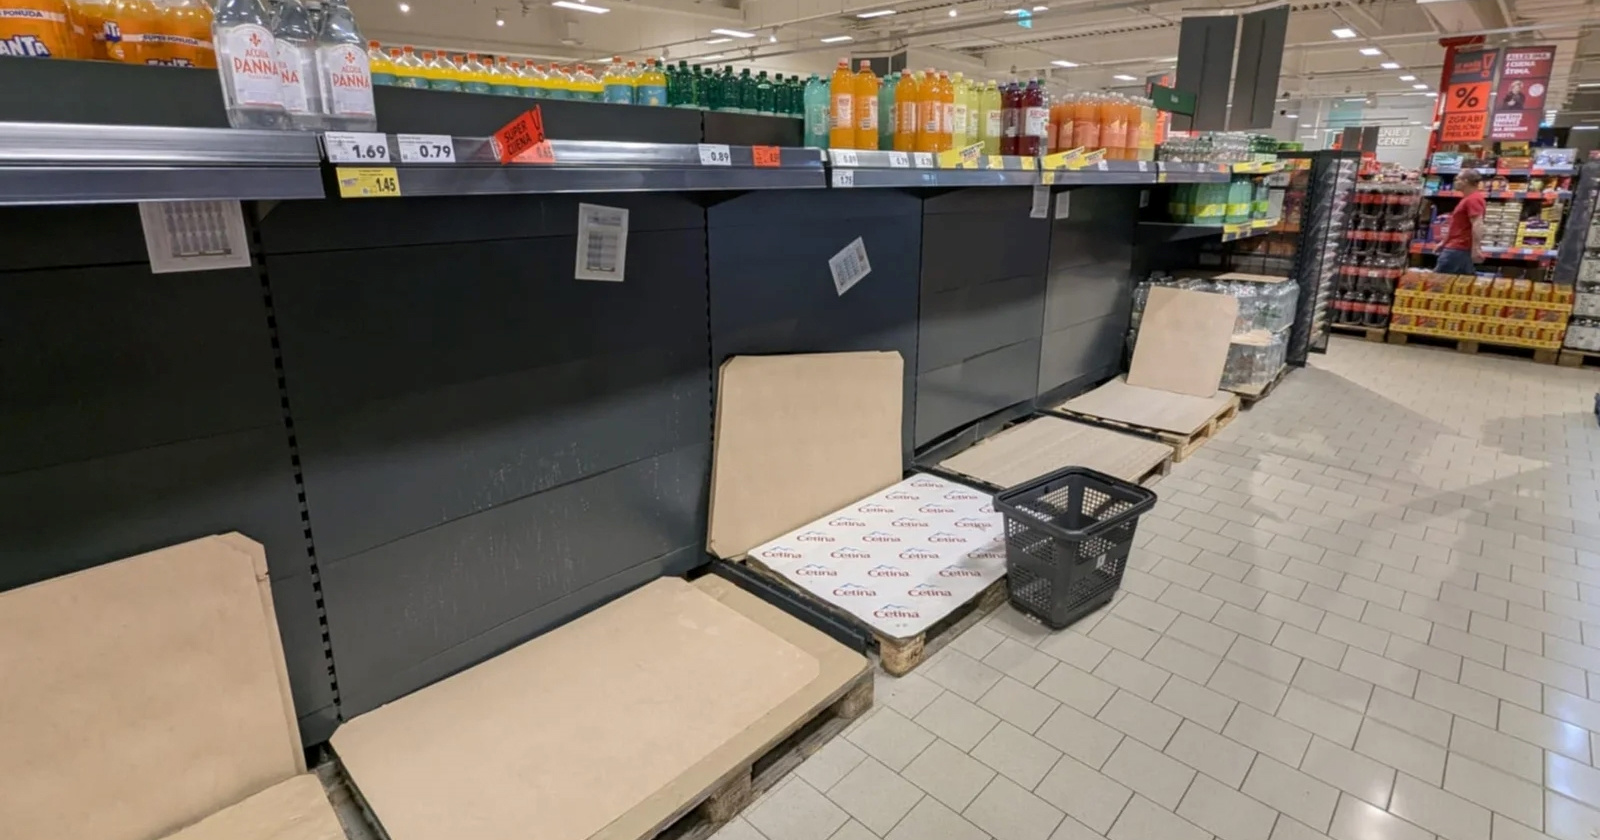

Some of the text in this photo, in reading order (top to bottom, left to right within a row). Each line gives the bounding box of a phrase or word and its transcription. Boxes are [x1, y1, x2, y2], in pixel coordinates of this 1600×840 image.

[3, 10, 43, 18] PONUDA
[0, 35, 51, 57] ANTA
[233, 57, 279, 76] PANNA
[332, 73, 370, 88] PANNA
[1447, 114, 1484, 124] ZGRABI
[503, 119, 527, 142] SUPER
[507, 132, 533, 156] CIJENA
[352, 144, 386, 159] 1.69
[420, 145, 451, 159] 0.79
[711, 152, 729, 162] 0.89
[376, 177, 396, 193] 1.45
[828, 520, 866, 528] Cetina
[892, 520, 929, 528] Cetina
[797, 534, 836, 543] Cetina
[862, 534, 901, 543] Cetina
[928, 535, 967, 543] Cetina
[762, 551, 802, 560] Cetina
[830, 551, 871, 560] Cetina
[899, 552, 940, 560] Cetina
[796, 568, 838, 577] Cetina
[867, 568, 910, 578] Cetina
[939, 568, 982, 578] Cetina
[833, 587, 876, 597] Cetina
[908, 587, 952, 597] Cetina
[873, 609, 920, 619] Cetina
